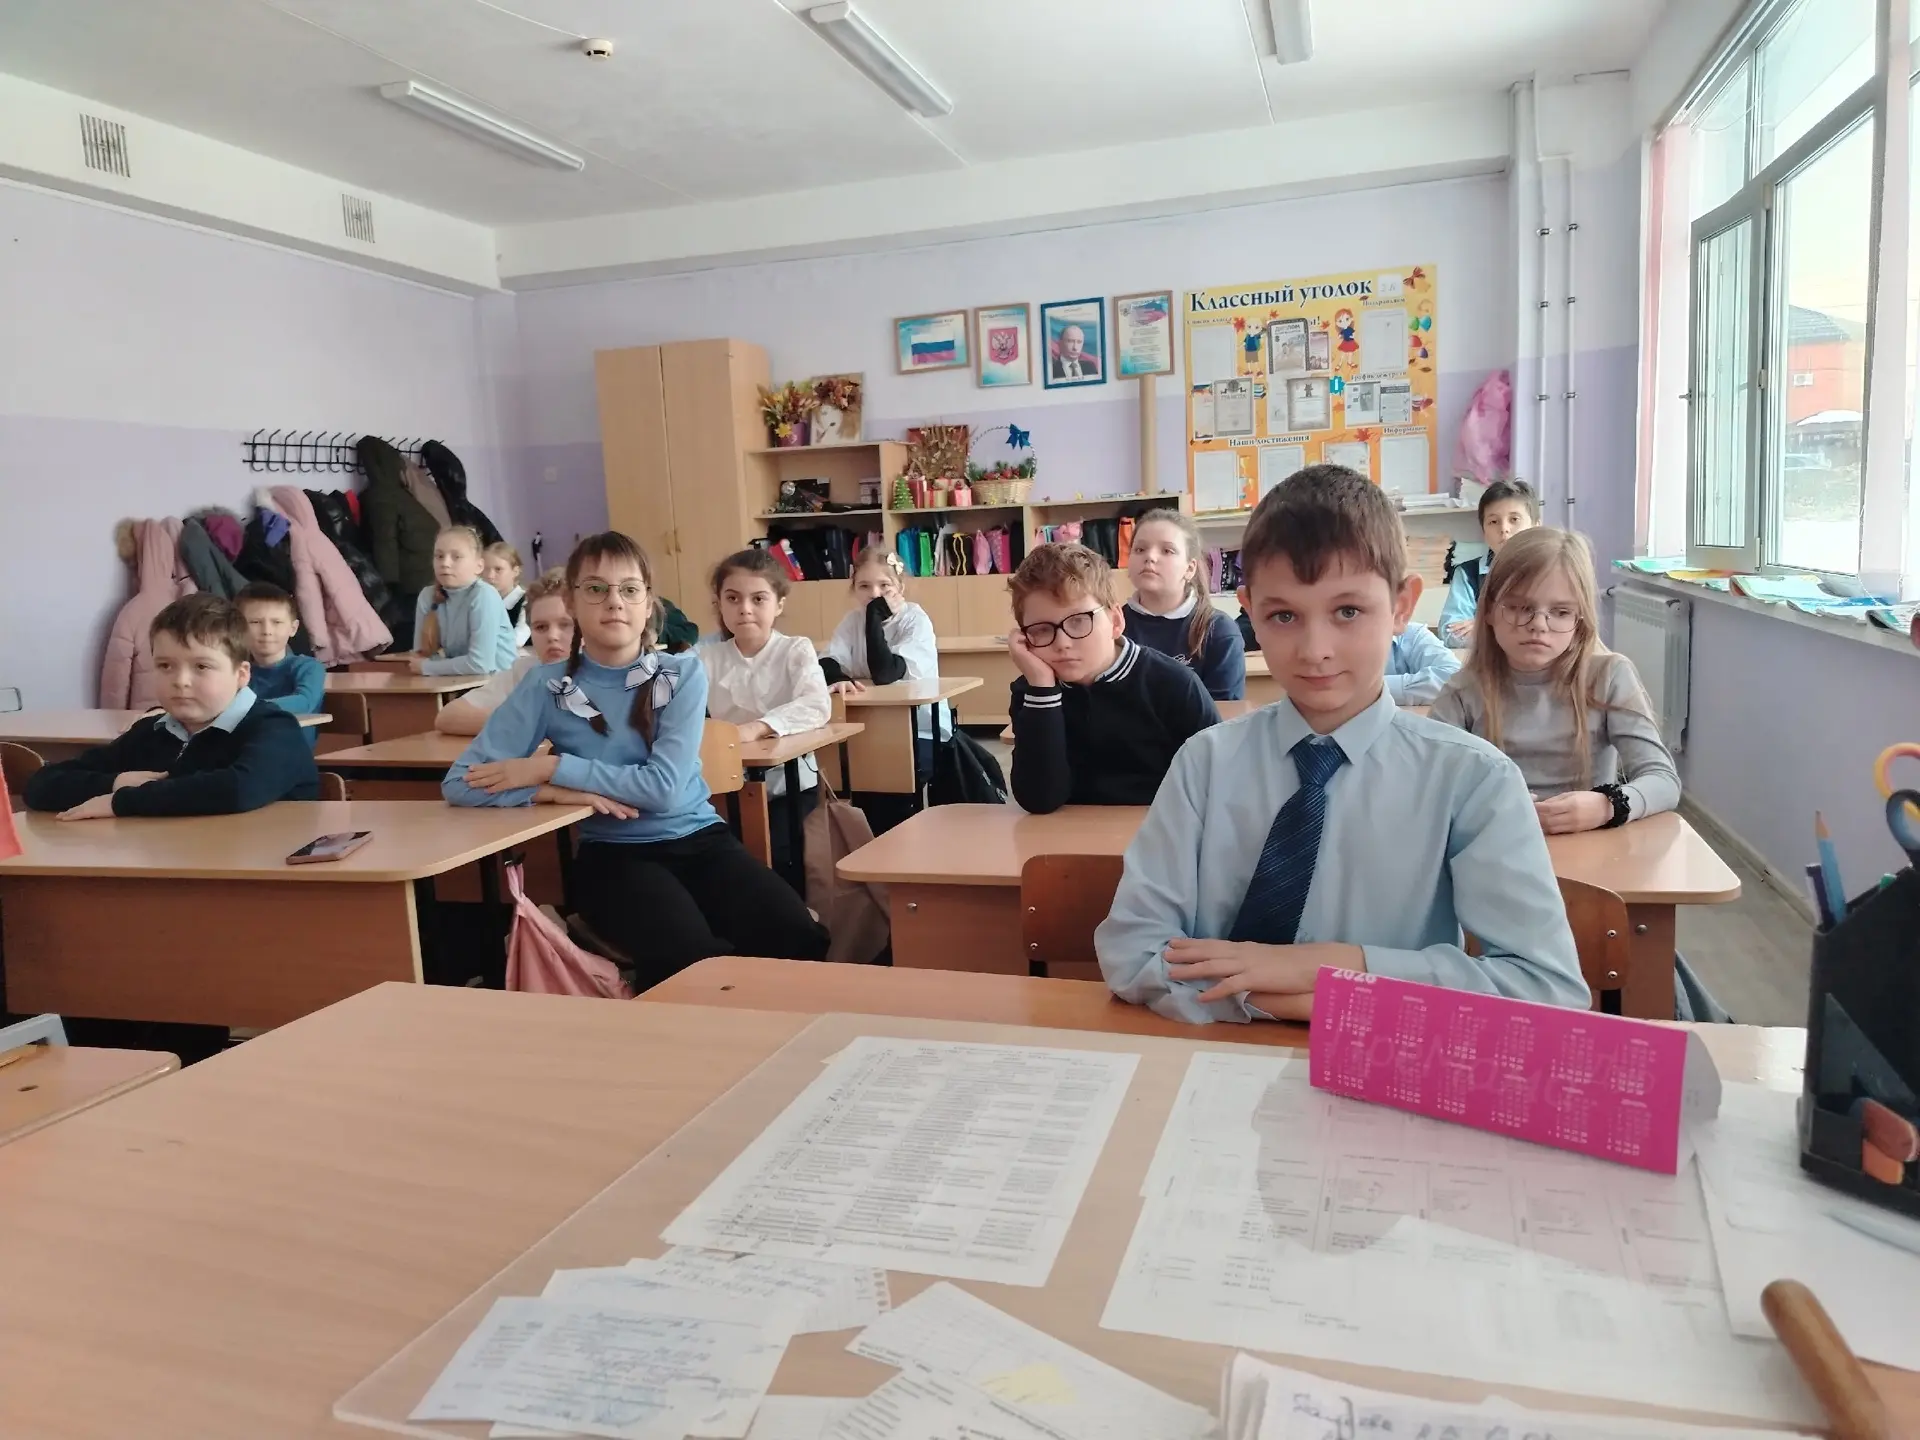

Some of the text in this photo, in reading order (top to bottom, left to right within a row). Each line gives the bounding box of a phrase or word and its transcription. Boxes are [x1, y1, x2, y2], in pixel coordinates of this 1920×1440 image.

[1190, 280, 1372, 312] Классный уголок
[1362, 297, 1406, 306] Поздравляем
[1351, 373, 1374, 381] График
[1383, 426, 1427, 434] Информация
[1229, 435, 1310, 447] Наши достижения
[1332, 968, 1377, 984] 2026
